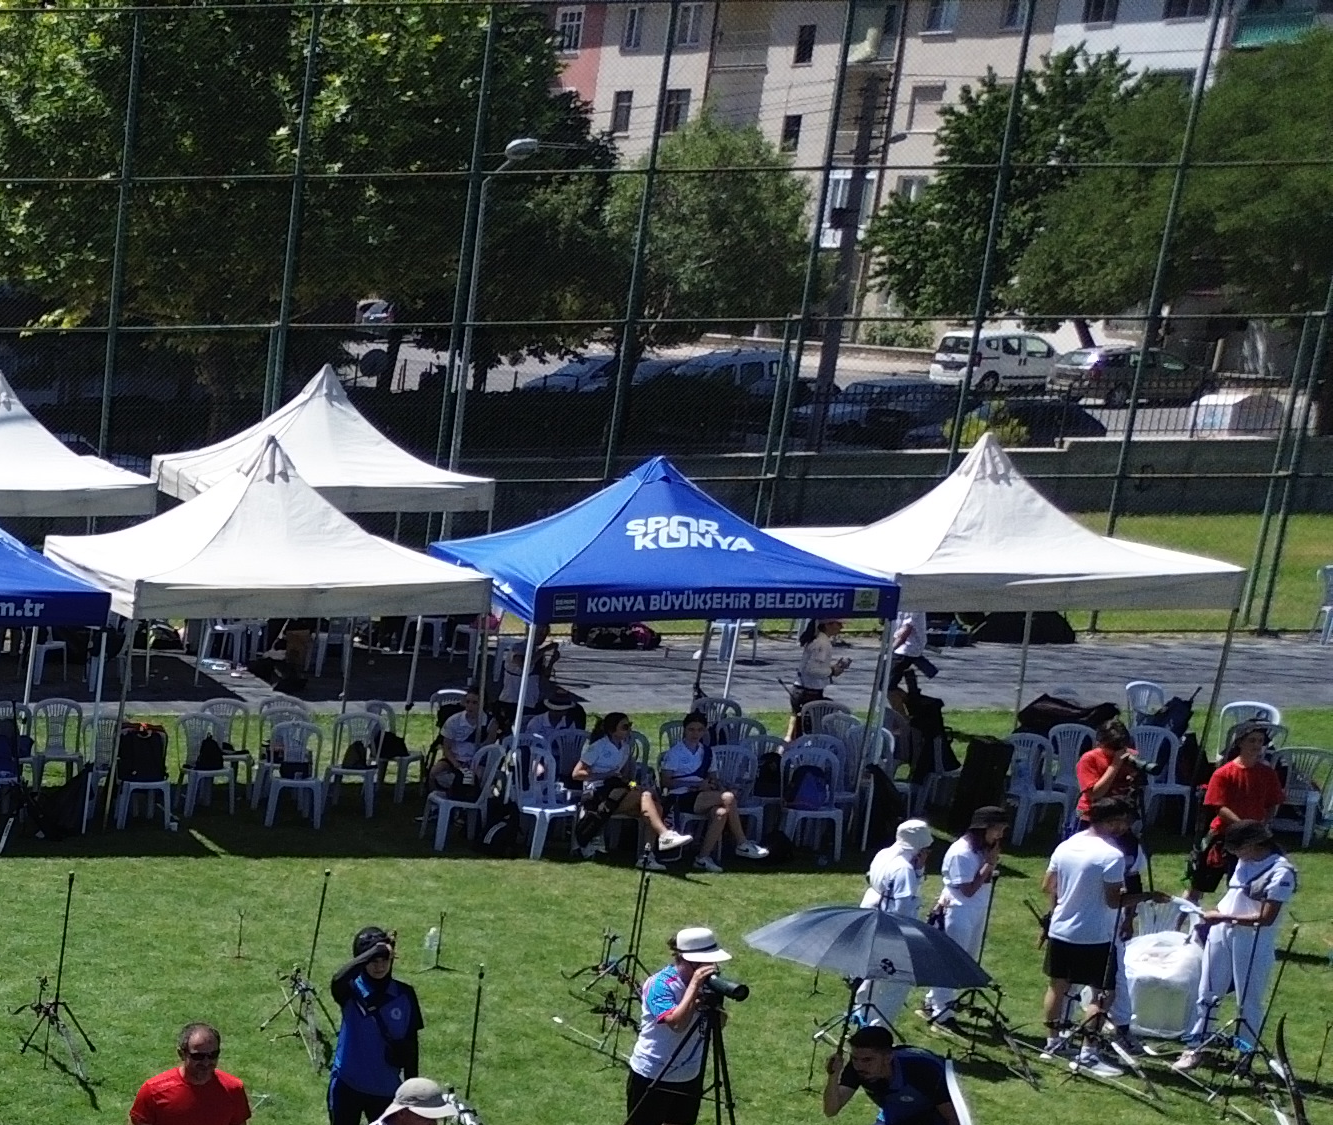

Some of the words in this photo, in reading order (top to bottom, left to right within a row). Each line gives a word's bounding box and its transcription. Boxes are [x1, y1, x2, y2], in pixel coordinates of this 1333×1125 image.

[625, 515, 719, 538] SPOR
[634, 526, 755, 552] KONYA
[586, 596, 645, 613] KONYA
